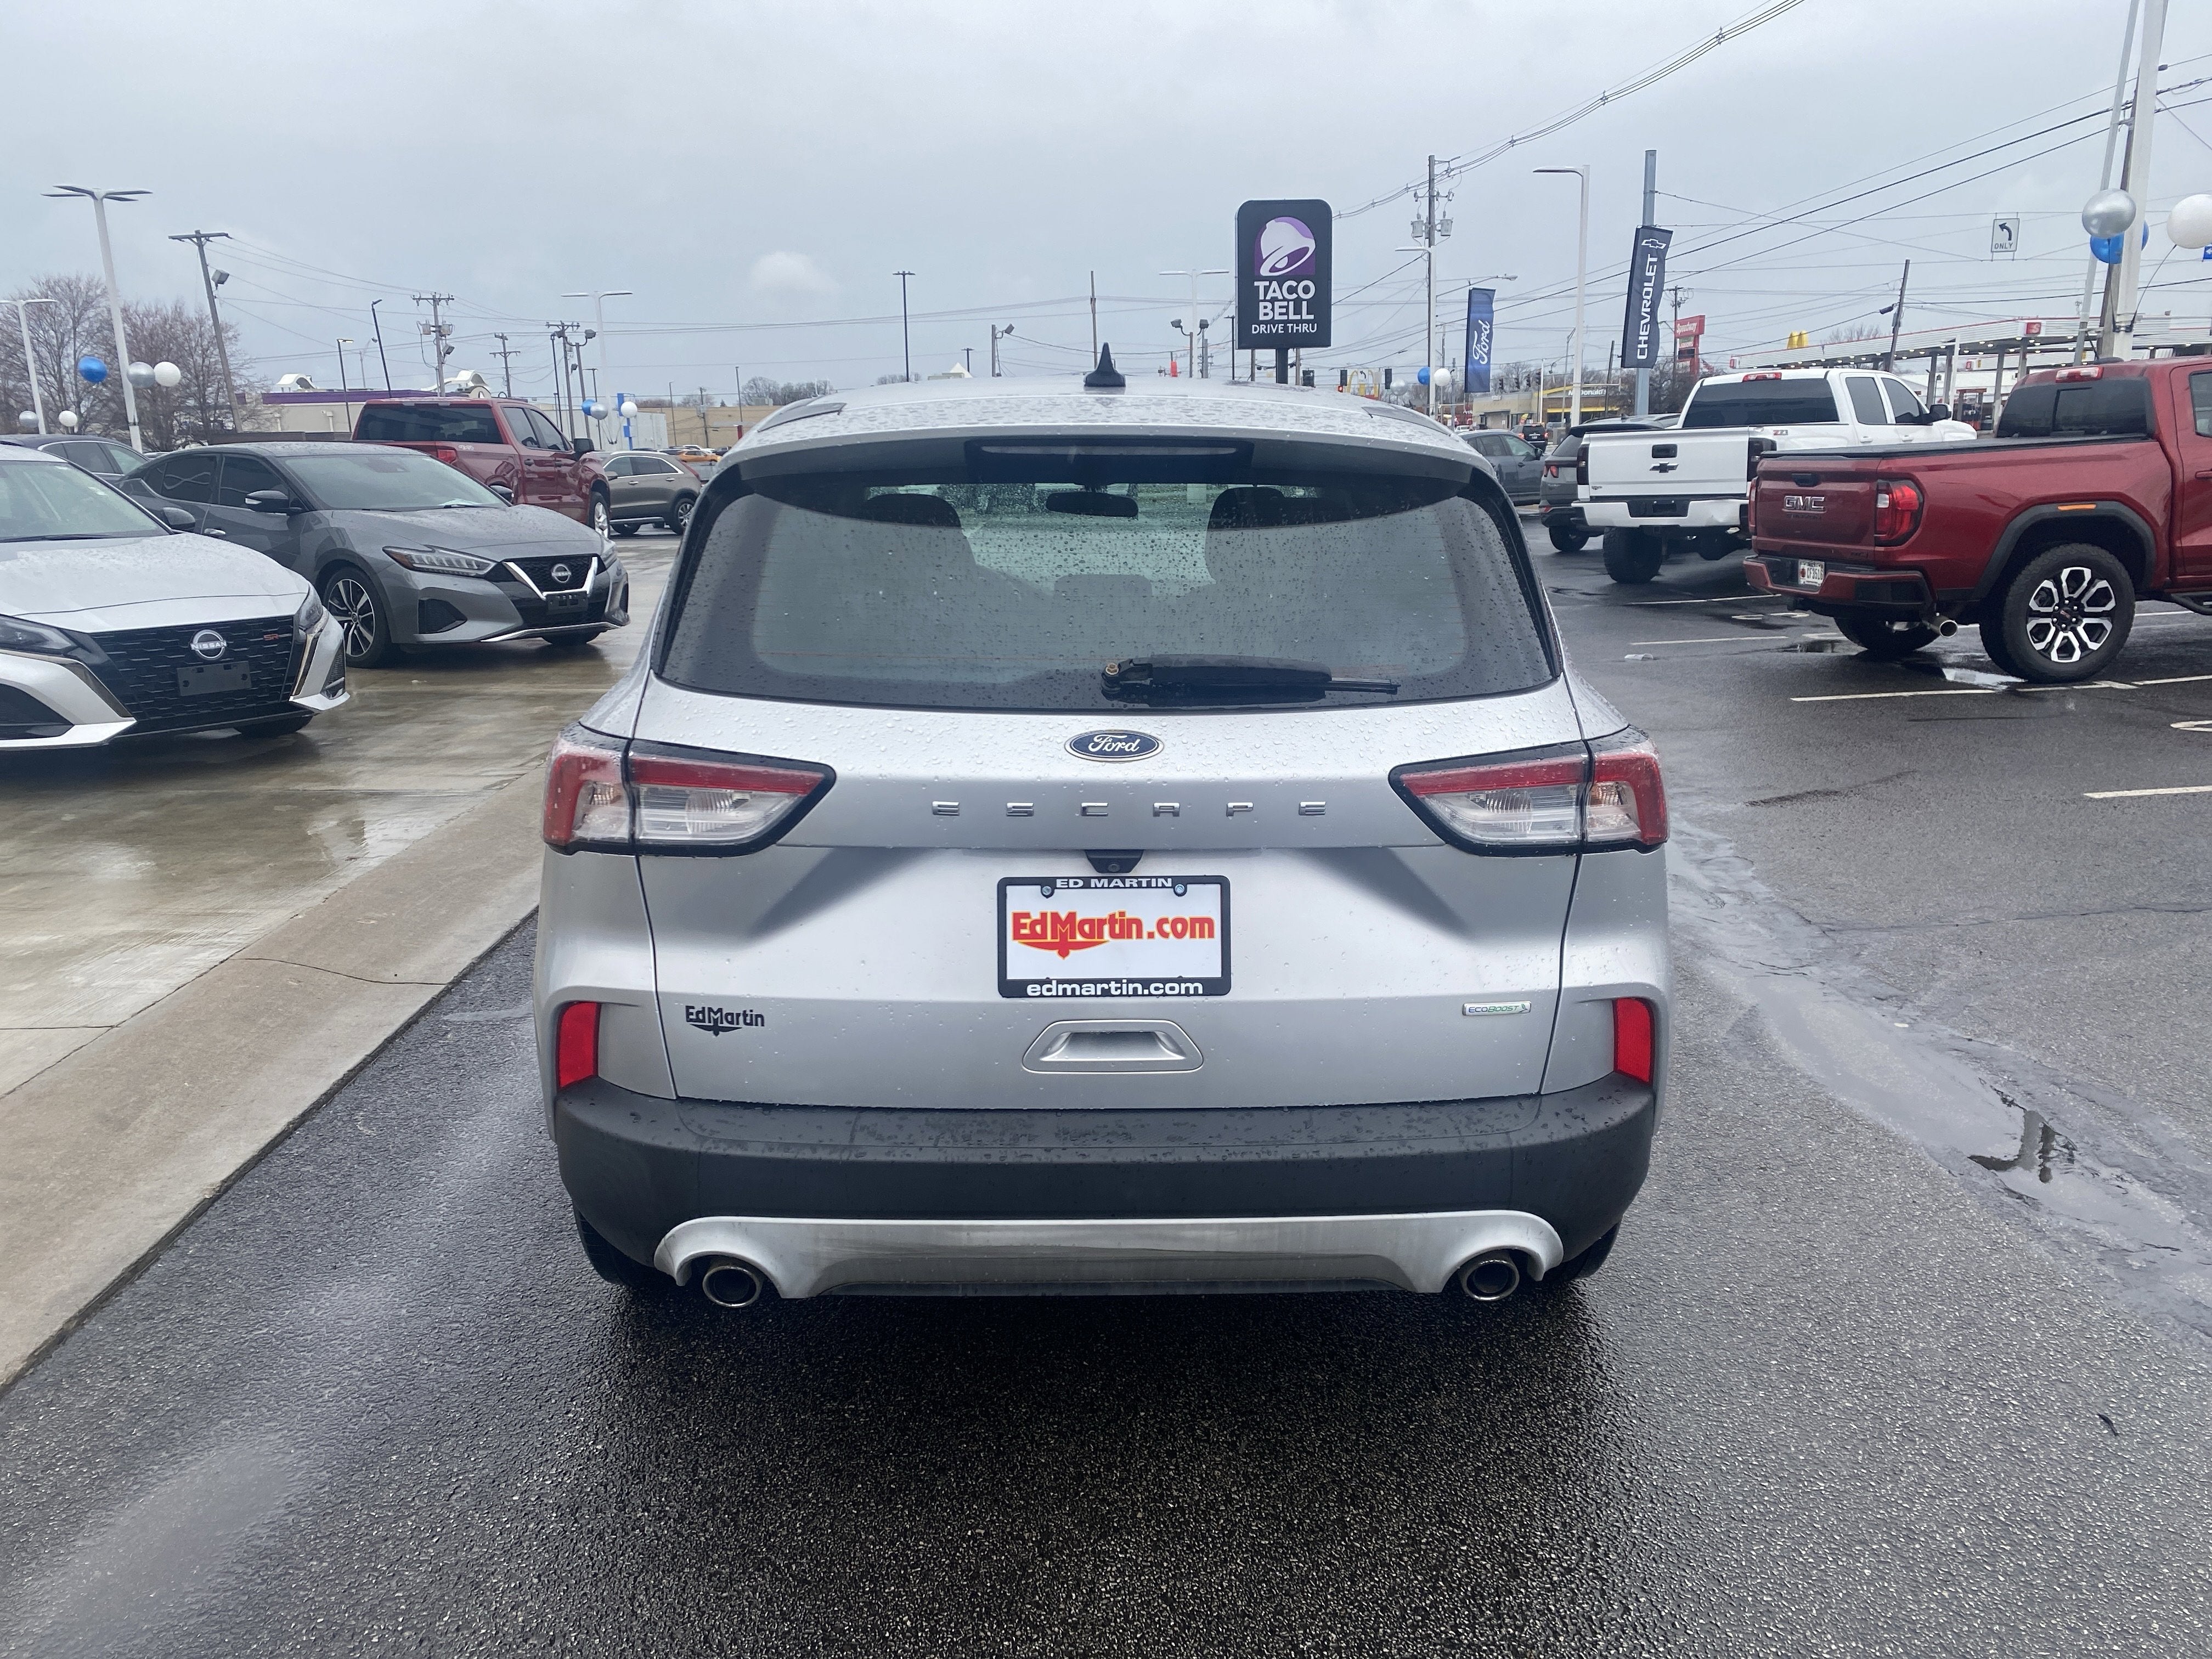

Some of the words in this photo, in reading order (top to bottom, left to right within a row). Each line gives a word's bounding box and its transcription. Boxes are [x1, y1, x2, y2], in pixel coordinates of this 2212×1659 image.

[1254, 280, 1316, 300] TACO
[1259, 301, 1314, 320] BELL
[1637, 253, 1658, 360] CHEVROLET
[1251, 323, 1284, 334] DRIVE
[1286, 323, 1317, 334] THRU
[1472, 319, 1491, 365] Ford
[1784, 495, 1825, 511] GMC
[191, 641, 227, 651] NISSAN
[1088, 734, 1141, 752] Ford
[932, 800, 1327, 817] ESCAPE
[1056, 878, 1084, 888] ED
[1090, 878, 1172, 888] MARTIN
[1026, 979, 1203, 996] edmartin.com
[685, 1005, 765, 1037] EdMartin
